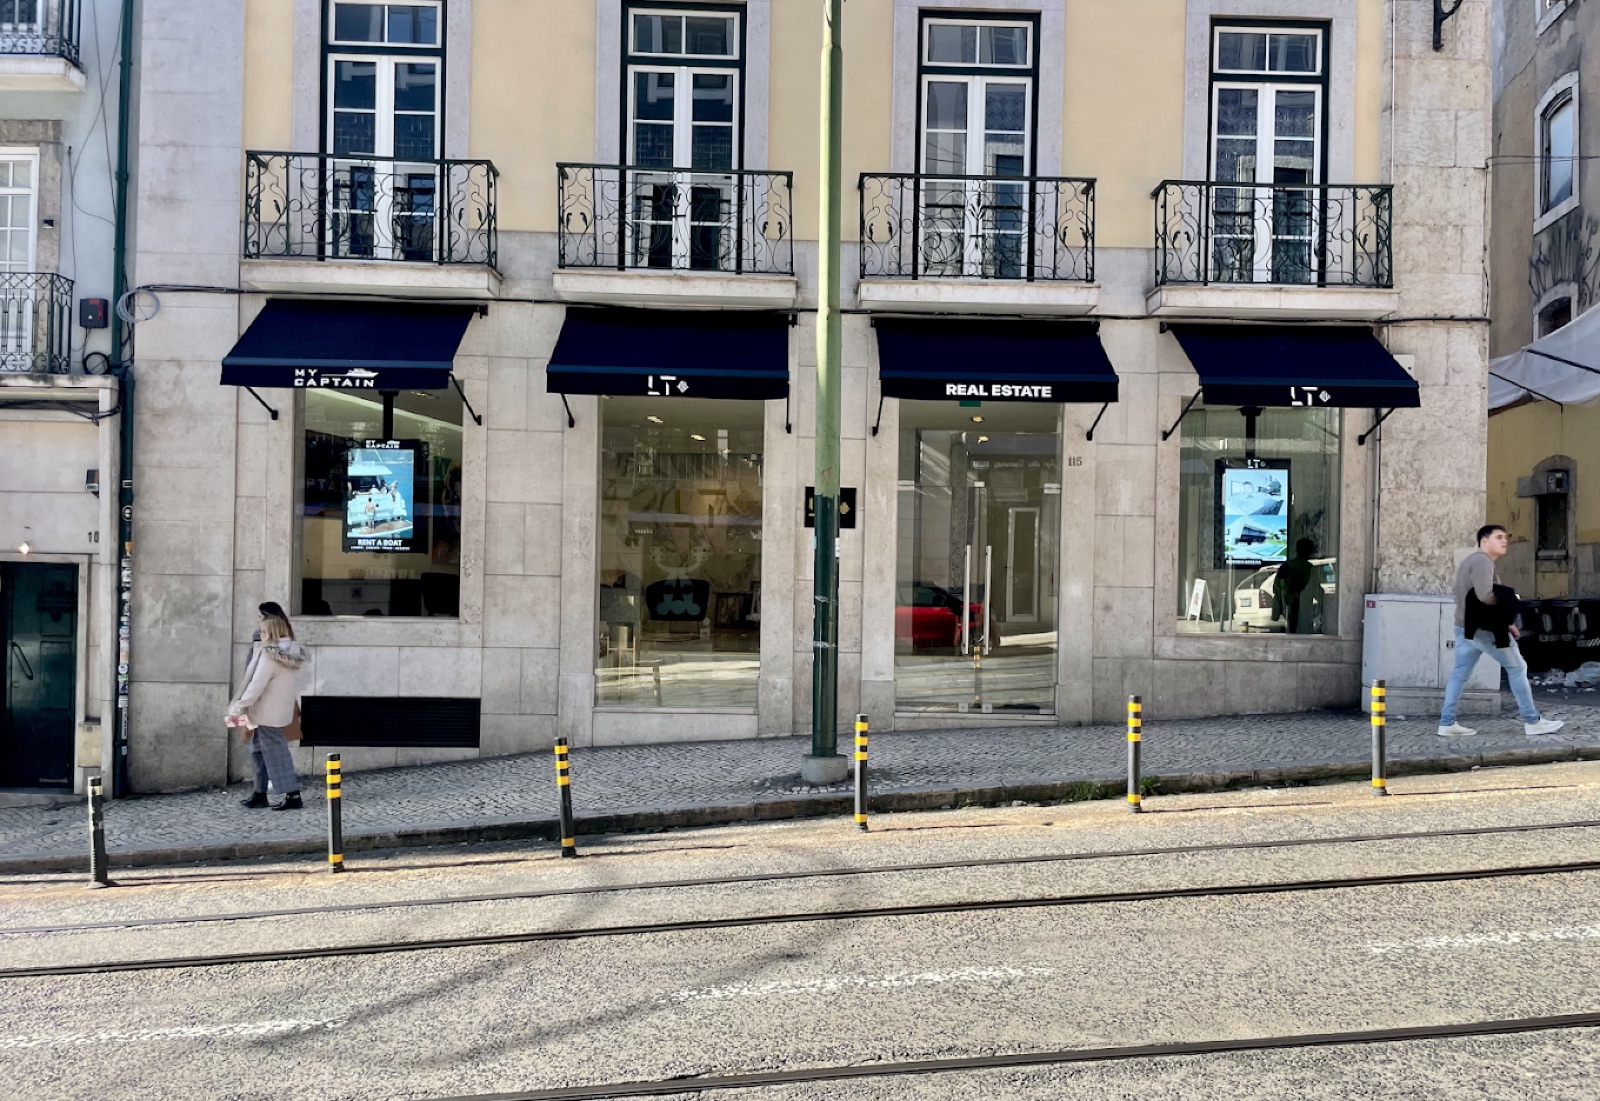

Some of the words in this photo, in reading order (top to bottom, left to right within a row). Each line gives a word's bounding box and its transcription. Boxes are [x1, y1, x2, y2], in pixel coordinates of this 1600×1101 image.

[294, 368, 318, 377] MY
[294, 377, 375, 388] CAPTAIN
[945, 383, 989, 397] REAL
[991, 385, 1052, 398] ESTATE
[1067, 456, 1083, 467] 115
[383, 539, 403, 547] BOAT
